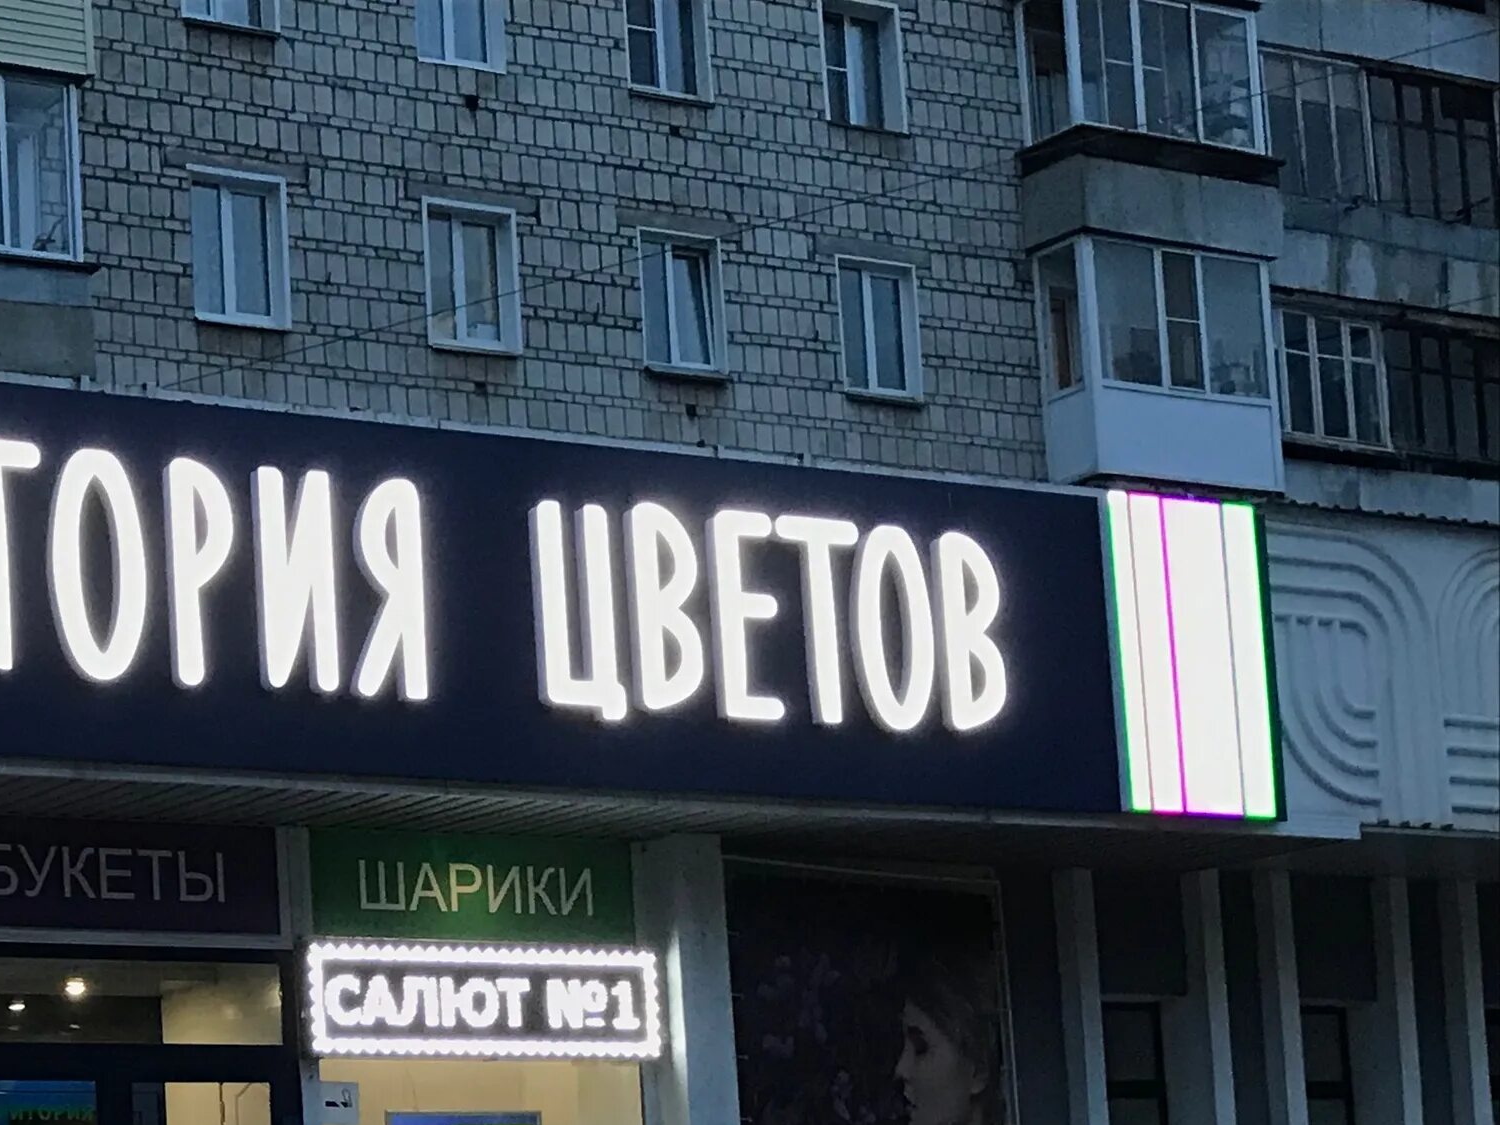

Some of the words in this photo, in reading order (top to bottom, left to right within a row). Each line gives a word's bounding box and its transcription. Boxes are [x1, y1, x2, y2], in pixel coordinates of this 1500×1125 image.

[529, 499, 1007, 731] ЦВЕТОВ
[358, 858, 595, 917] ШАРИКИ
[323, 973, 531, 1028] САЛЮТ
[545, 977, 641, 1030] №1
